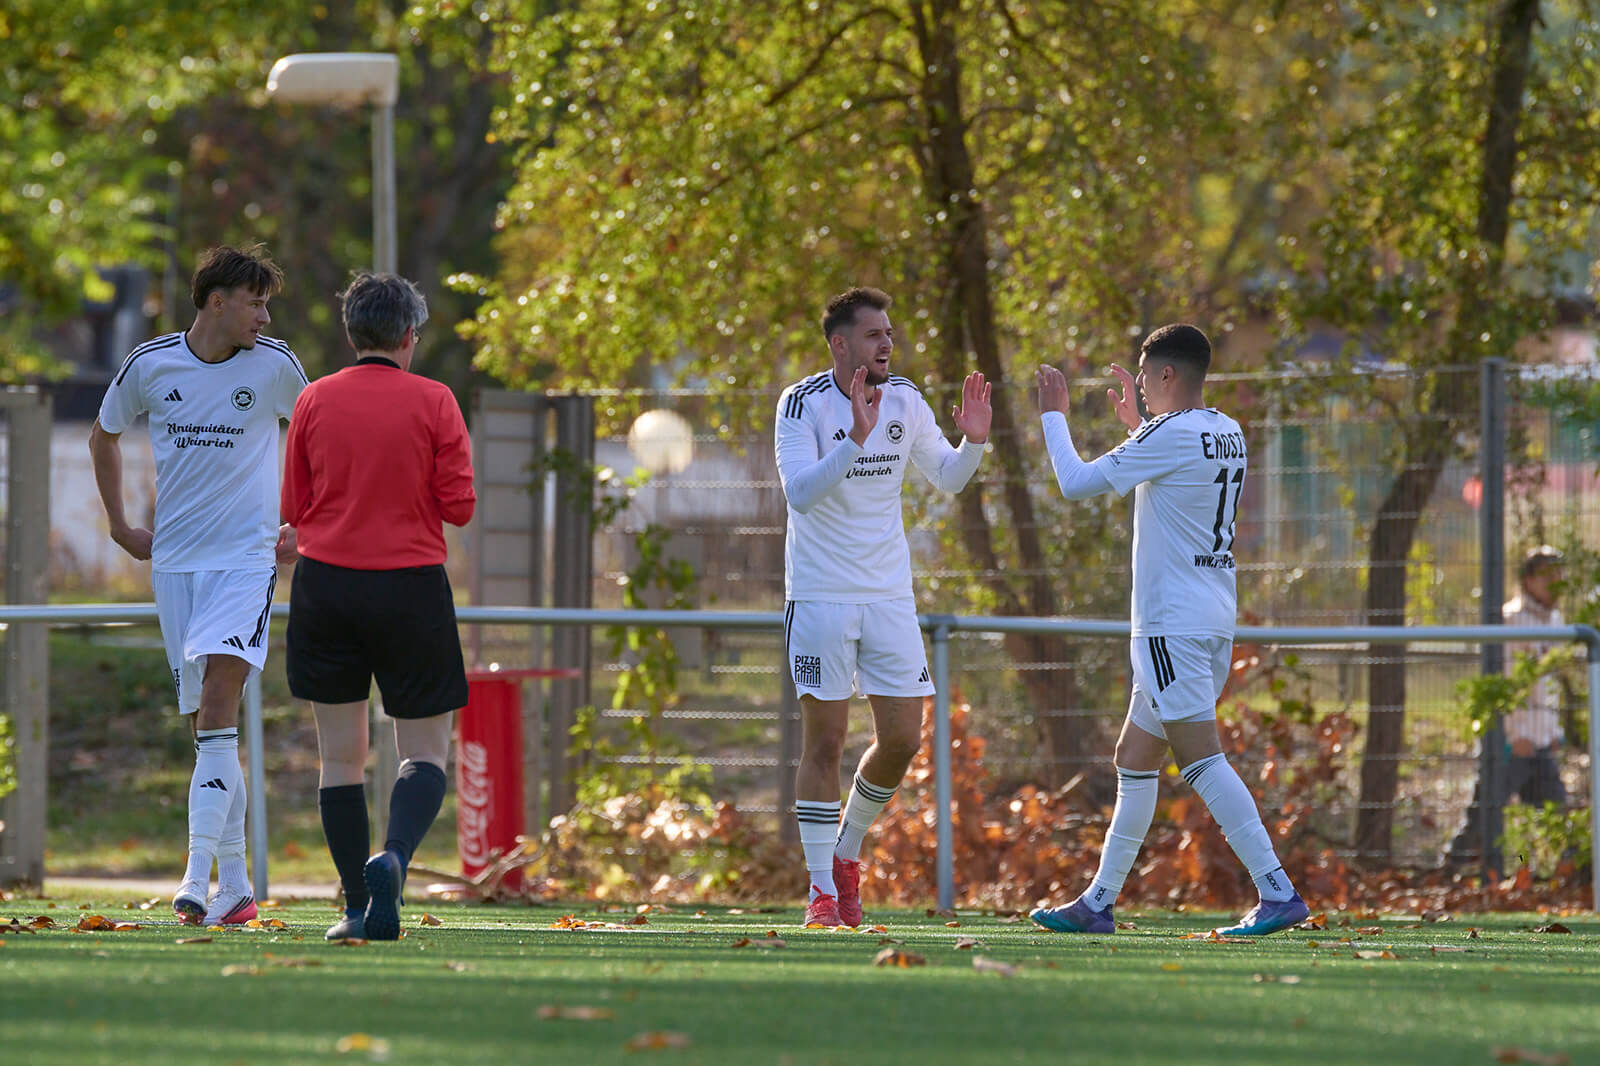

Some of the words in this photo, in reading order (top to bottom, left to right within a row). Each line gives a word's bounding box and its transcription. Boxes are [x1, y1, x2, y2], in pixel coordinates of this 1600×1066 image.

[167, 422, 244, 435] Antiquitäten
[174, 436, 234, 448] Weinrich
[854, 453, 900, 465] quitäten
[1213, 468, 1244, 552] 11
[795, 655, 821, 665] PIZZA
